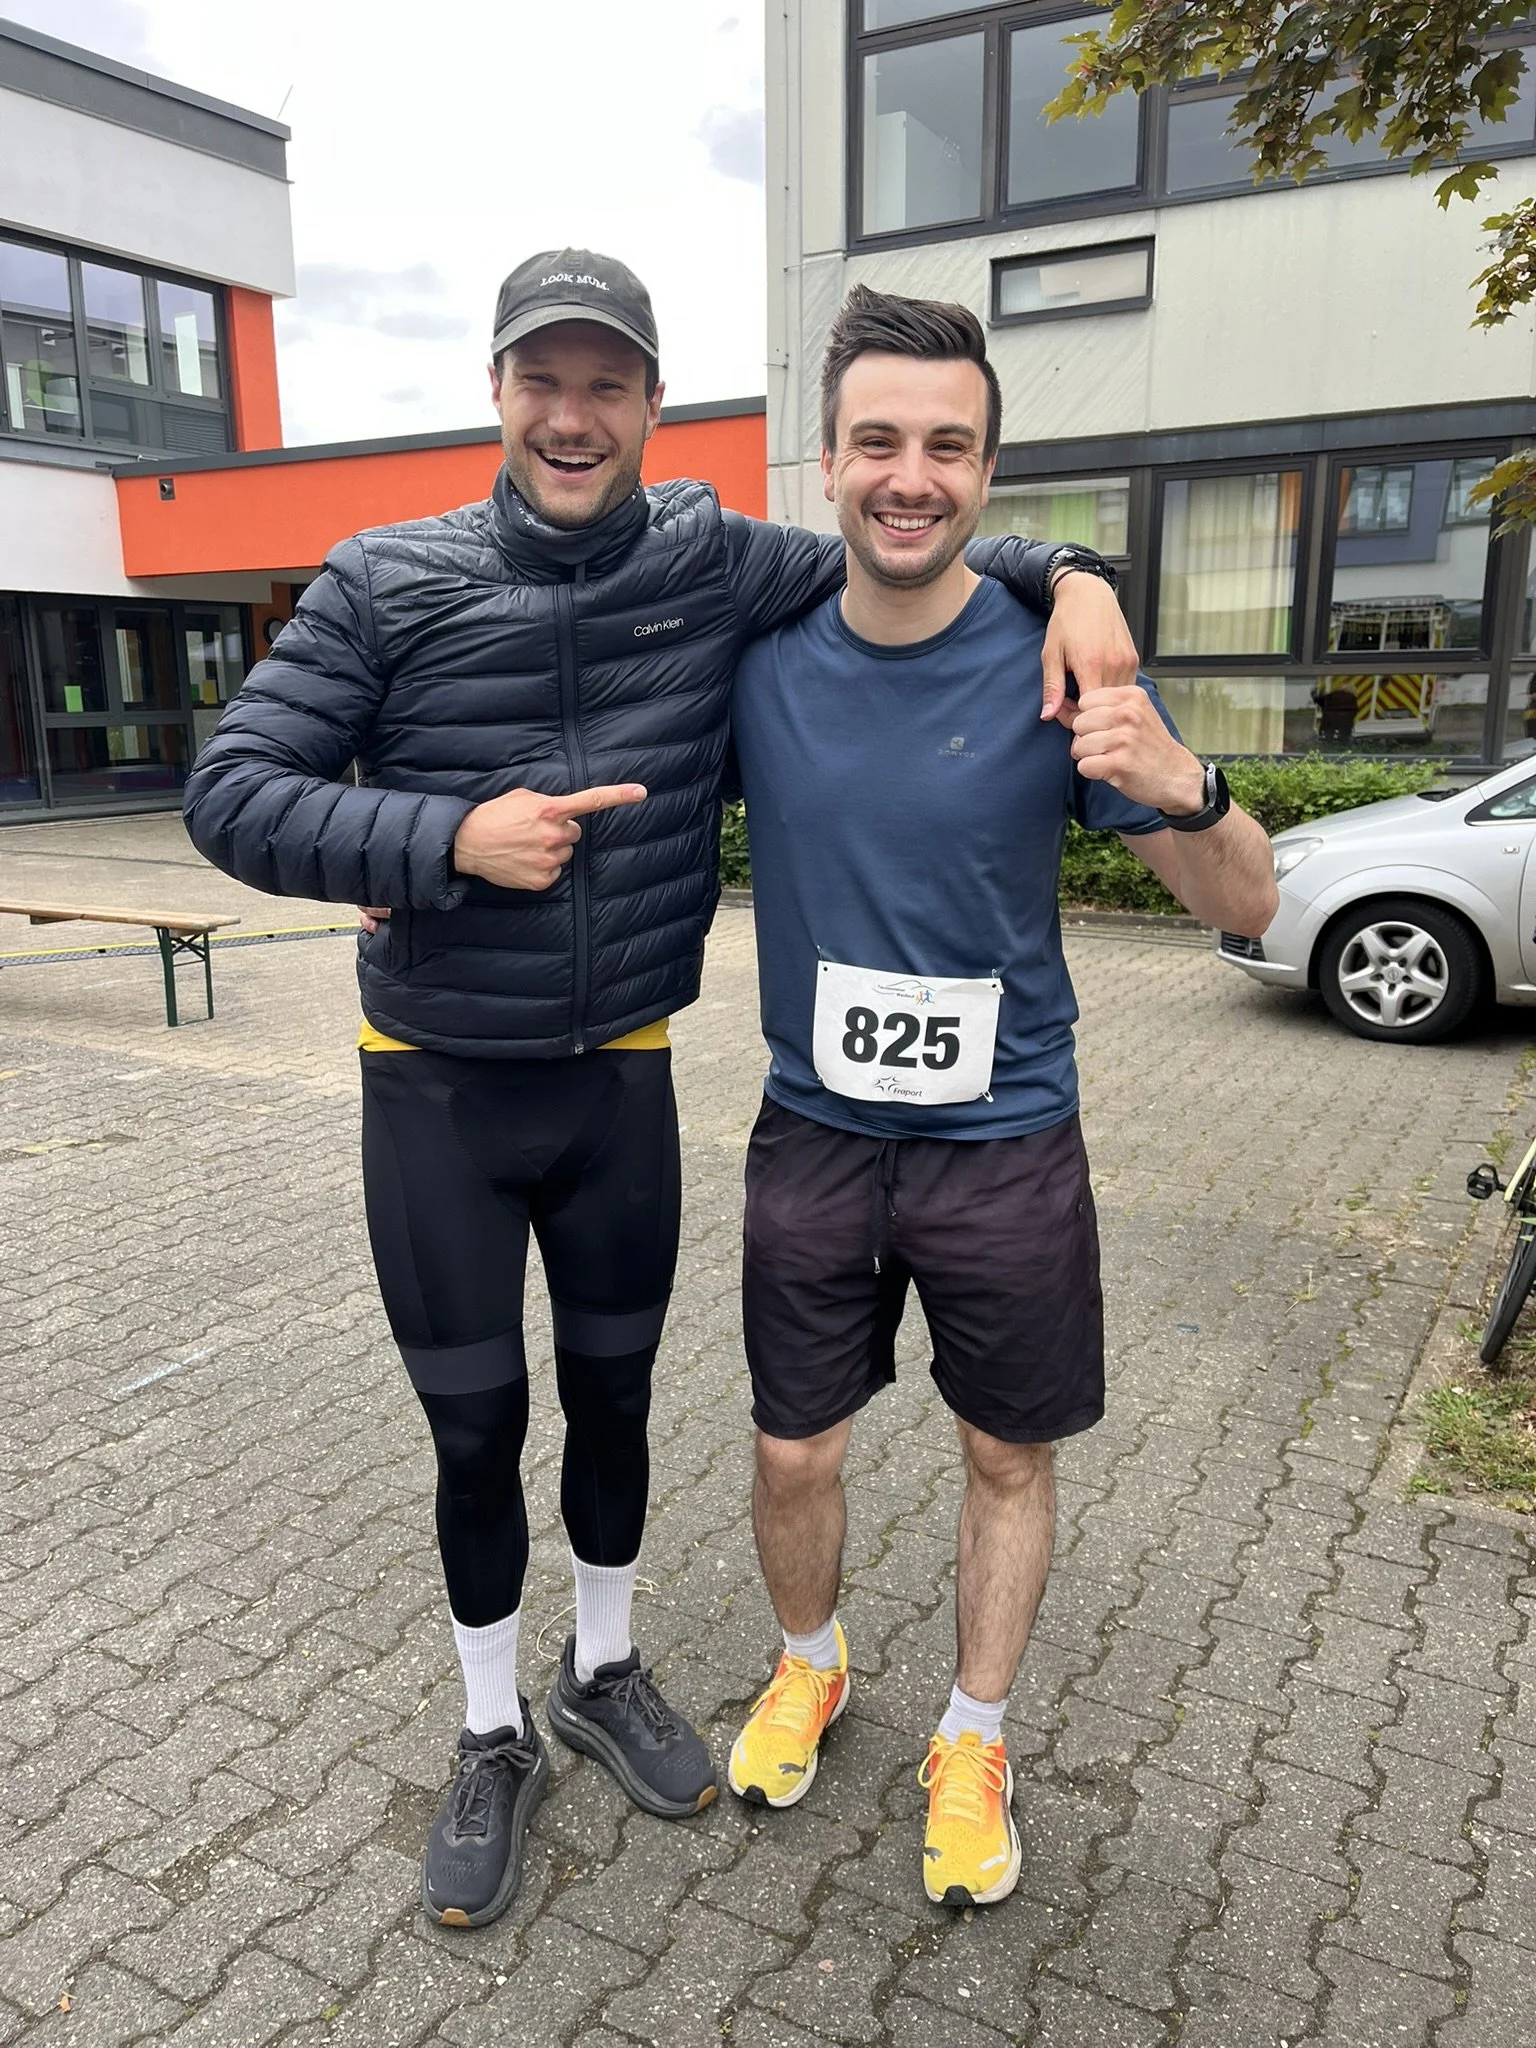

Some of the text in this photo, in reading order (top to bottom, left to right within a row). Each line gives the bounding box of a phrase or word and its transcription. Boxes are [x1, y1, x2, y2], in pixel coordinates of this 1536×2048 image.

[540, 273, 610, 291] LOOK MUM.
[634, 617, 684, 637] Calvin Klein
[842, 1006, 960, 1070] 825
[893, 1087, 922, 1097] Fraport
